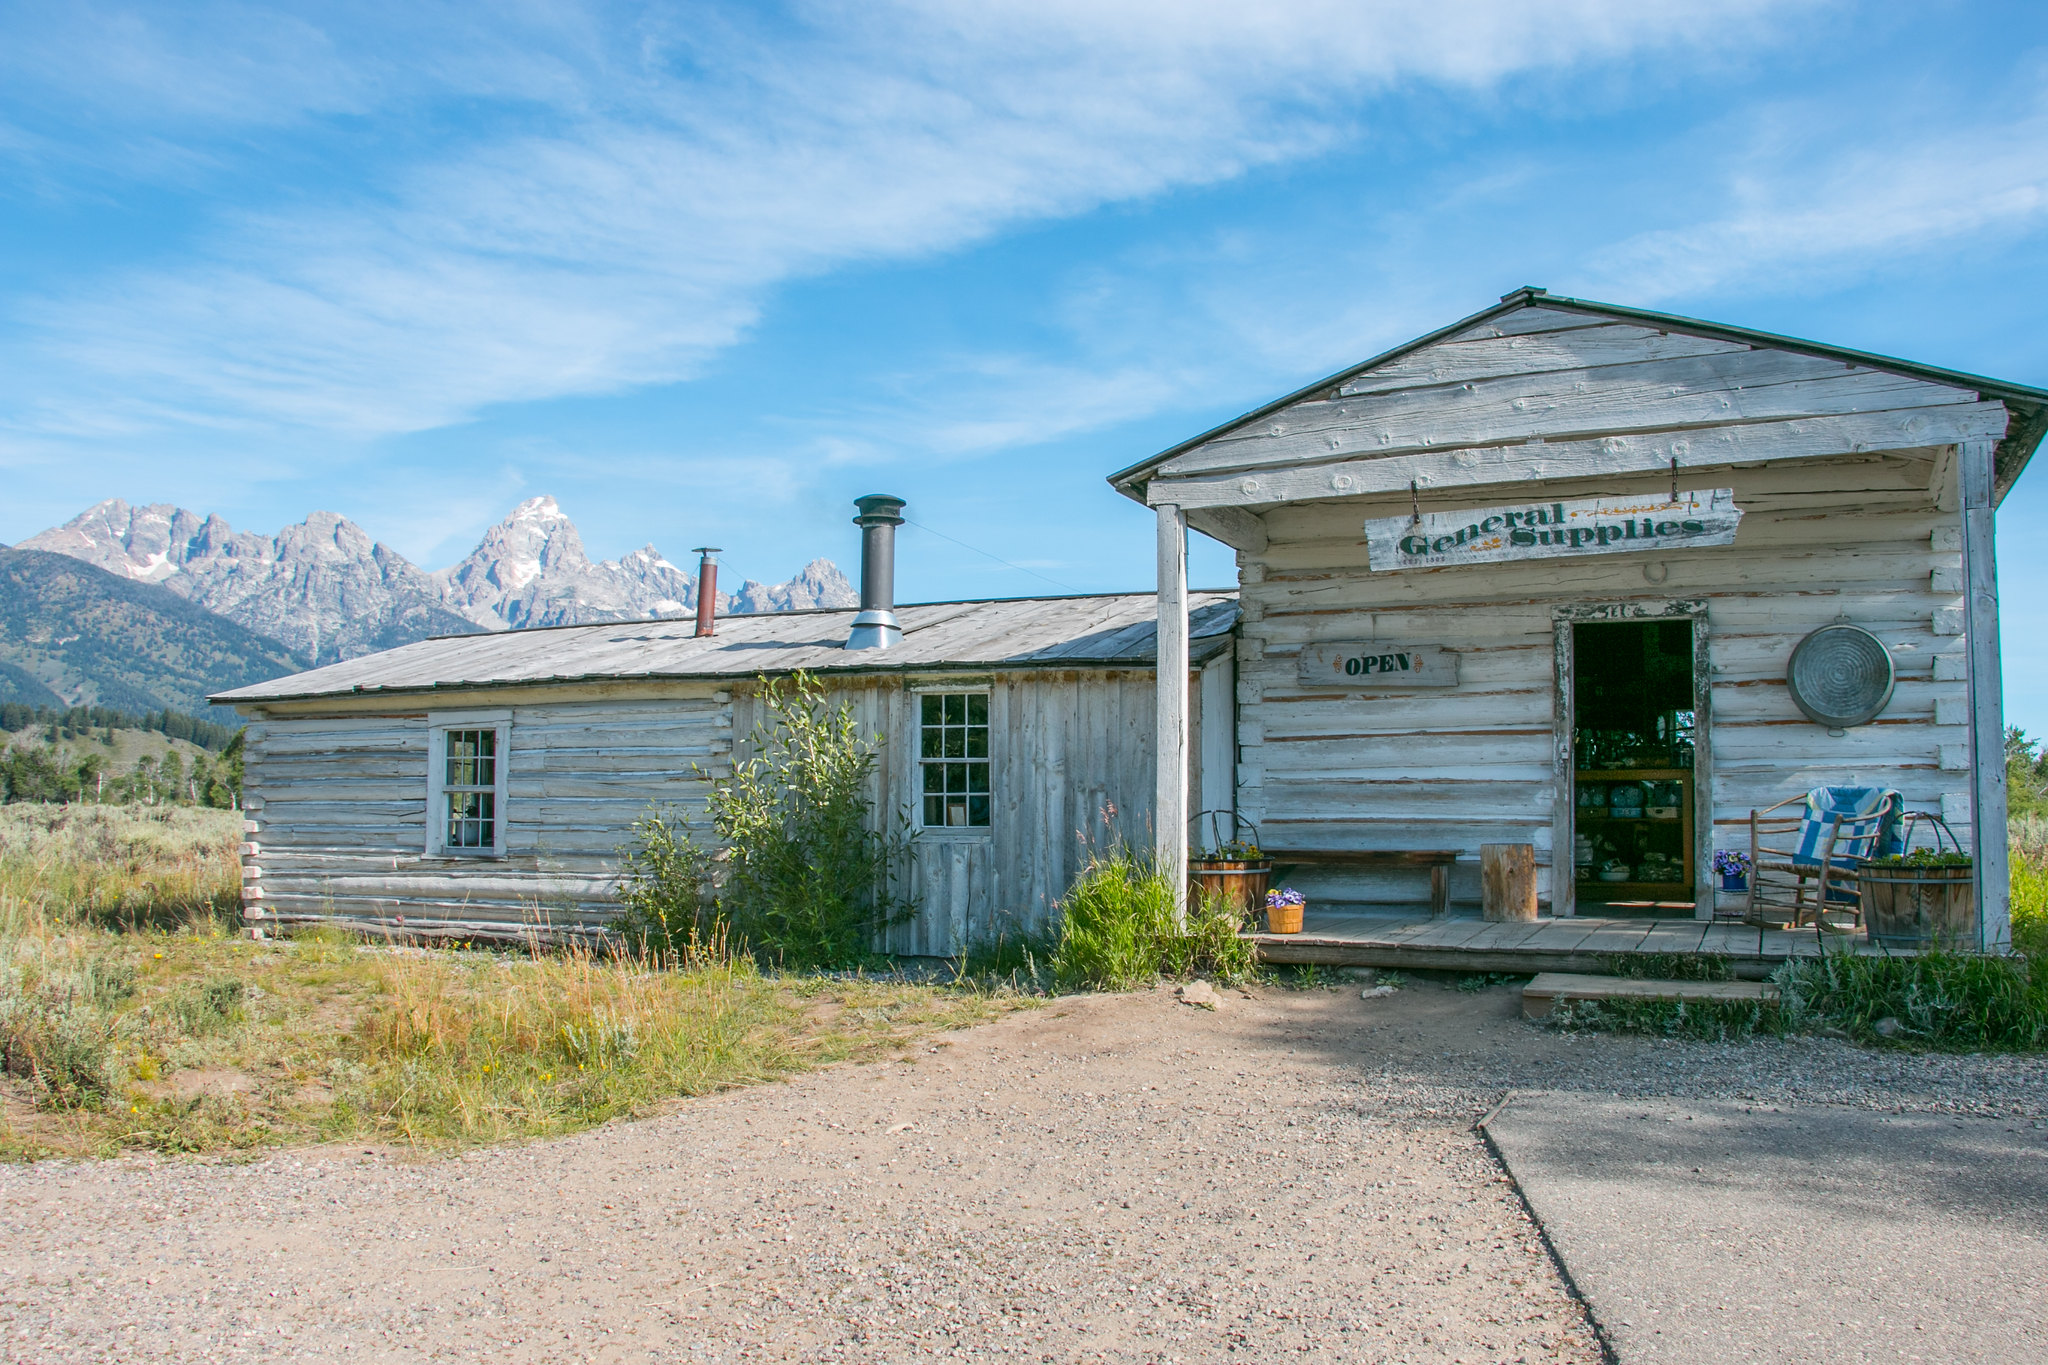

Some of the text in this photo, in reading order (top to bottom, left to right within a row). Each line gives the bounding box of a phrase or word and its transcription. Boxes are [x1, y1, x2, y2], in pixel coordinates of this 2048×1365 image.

[1399, 503, 1566, 555] General
[1510, 518, 1704, 547] Supplies
[1345, 653, 1411, 676] OPEN
